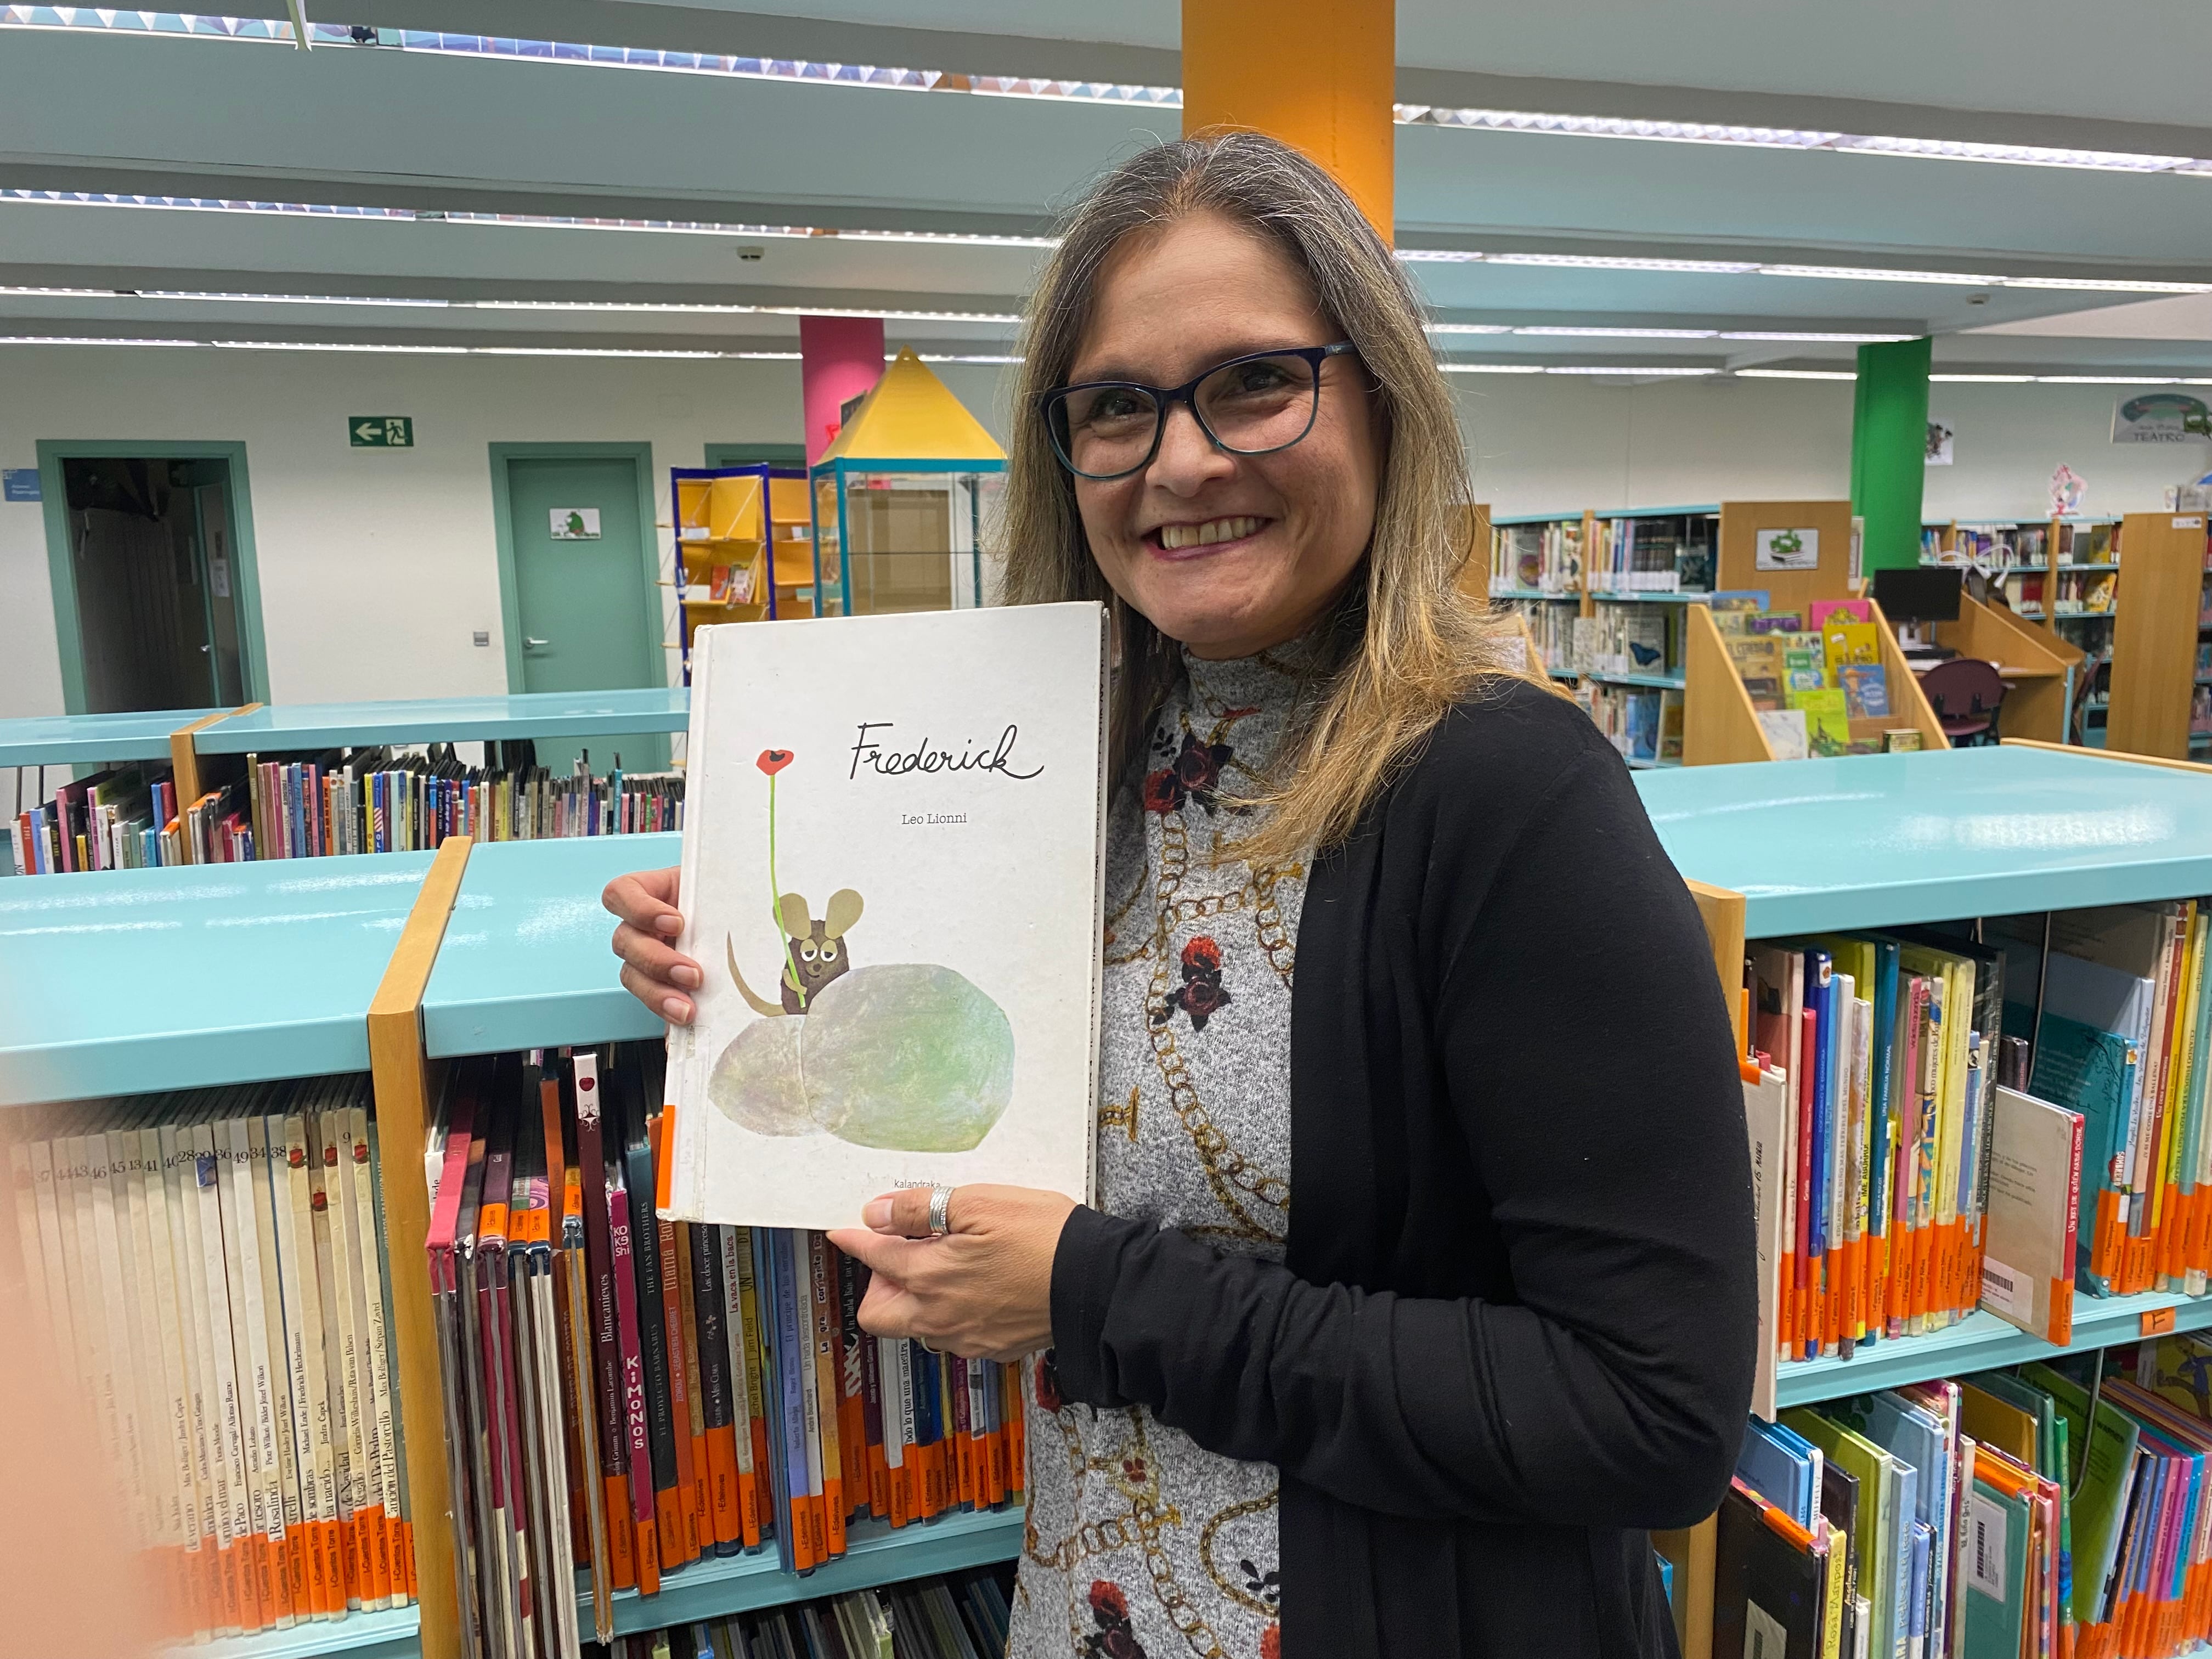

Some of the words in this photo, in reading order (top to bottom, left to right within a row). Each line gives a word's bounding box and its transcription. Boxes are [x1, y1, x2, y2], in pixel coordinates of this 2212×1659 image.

[849, 722, 1045, 780] Frederick
[901, 814, 923, 825] Leo
[927, 812, 967, 824] Lionni
[342, 1132, 351, 1144] 9
[271, 1146, 286, 1159] 38
[640, 1201, 652, 1252] BROTHERS
[725, 1235, 735, 1257] baca
[644, 1255, 653, 1273] FAN
[662, 1249, 678, 1291] Mamá
[725, 1259, 735, 1268] la
[728, 1269, 736, 1279] en
[645, 1275, 655, 1295] THE
[727, 1282, 737, 1302] vaca
[598, 1273, 614, 1343] Blancanieves
[729, 1304, 738, 1313] La
[744, 1317, 755, 1337] Field
[746, 1339, 758, 1353] Jim
[801, 1342, 811, 1360] hada
[748, 1366, 760, 1391] Bright
[901, 1380, 911, 1397] una
[608, 1392, 617, 1425] Benjamin
[902, 1398, 914, 1416] que
[302, 1429, 312, 1454] Michael
[379, 1411, 394, 1461] Pastorcillo
[383, 1463, 396, 1478] del
[304, 1469, 317, 1509] sombras
[234, 1503, 246, 1525] Paco
[252, 1489, 263, 1521] tesoro
[266, 1481, 282, 1535] Rosalinda
[309, 1527, 319, 1548] Torre
[327, 1530, 336, 1550] Torre
[392, 1522, 400, 1543] Torre
[1825, 1616, 1838, 1650] Rosa
